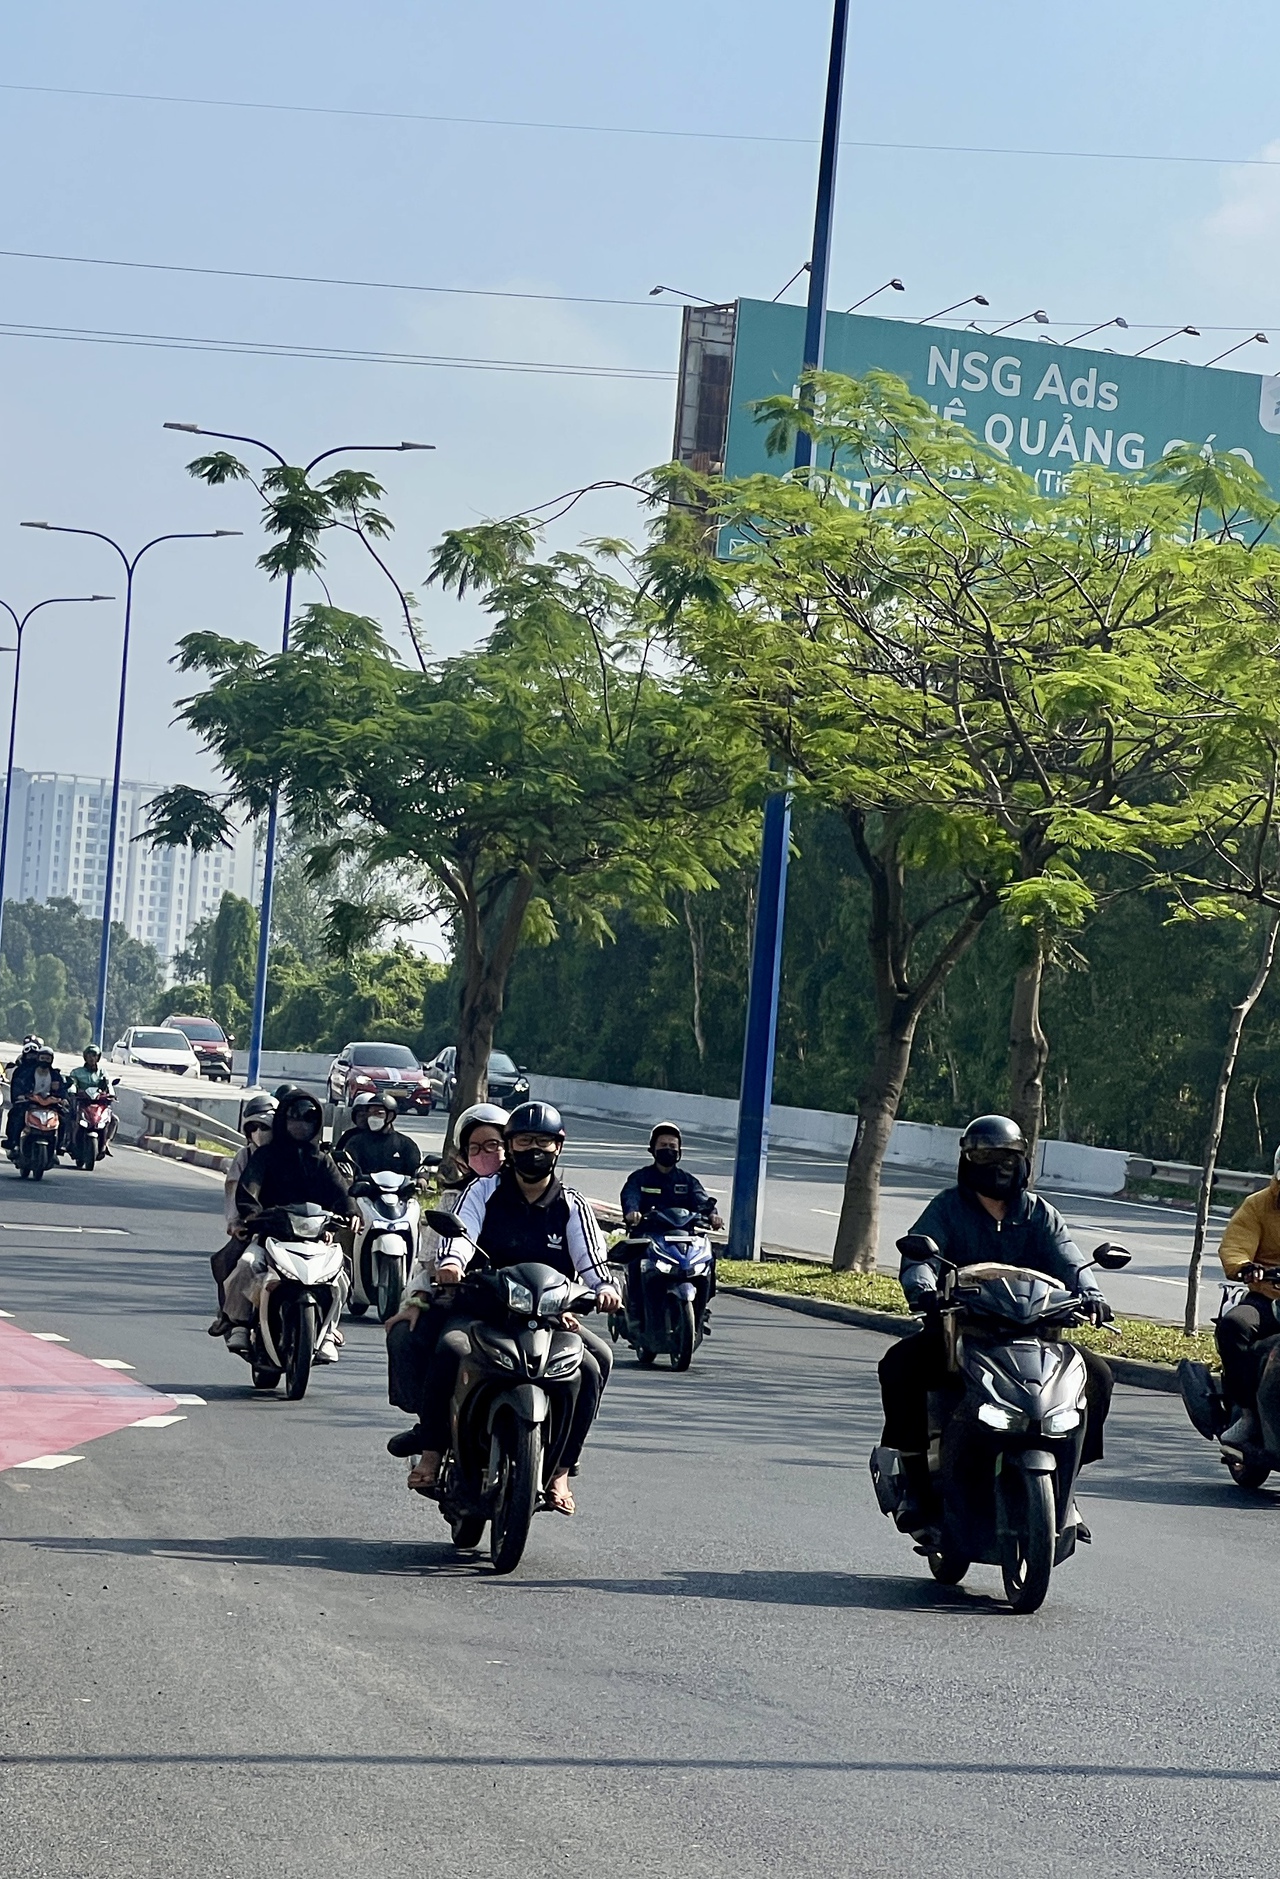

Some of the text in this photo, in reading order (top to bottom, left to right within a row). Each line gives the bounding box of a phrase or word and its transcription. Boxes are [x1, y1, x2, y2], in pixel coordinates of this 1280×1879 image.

[927, 345, 1119, 412] NSG Ads
[984, 412, 1146, 470] QUẢNG
